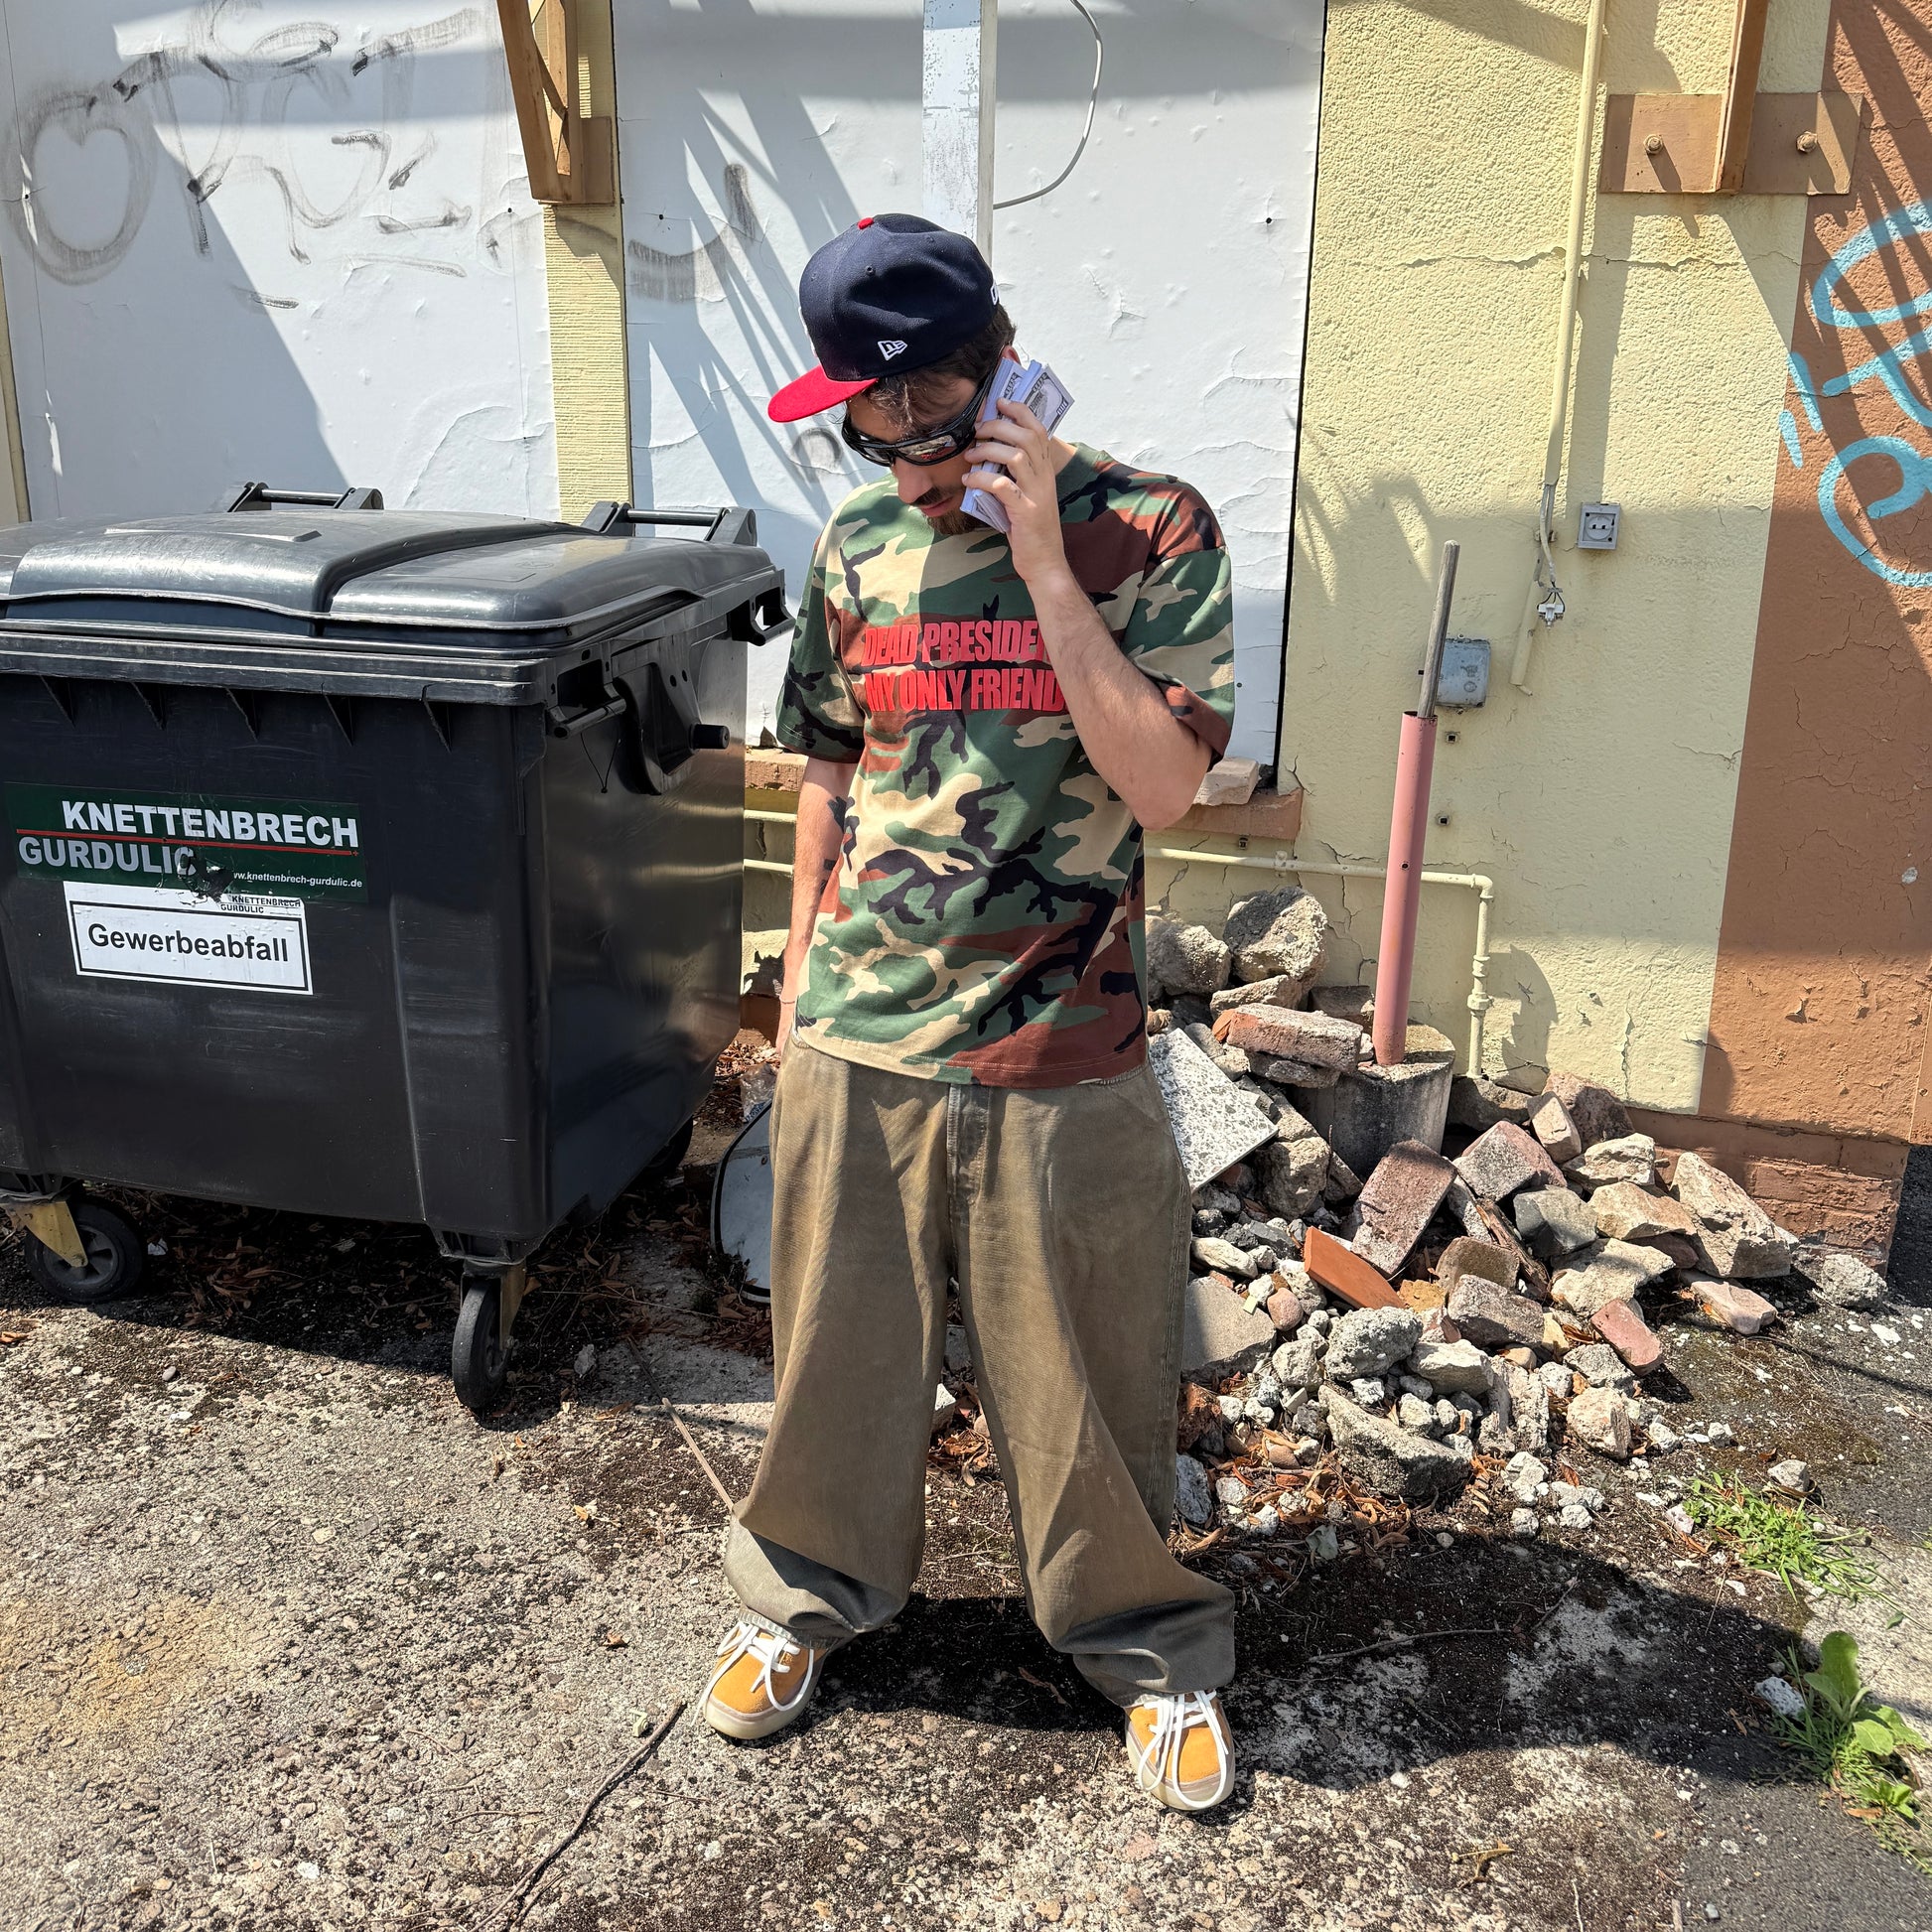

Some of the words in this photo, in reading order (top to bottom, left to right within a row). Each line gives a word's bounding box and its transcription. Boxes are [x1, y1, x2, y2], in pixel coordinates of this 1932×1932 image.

[861, 623, 918, 667] DEAD
[865, 672, 896, 712] MY
[899, 669, 966, 713] ONLY
[971, 668, 1068, 712] FRIEND
[62, 800, 359, 848] KNETTENBRECH
[18, 836, 197, 876] GURDULIC
[220, 903, 269, 913] GURDULIC
[231, 895, 301, 907] KNETTENBRECH
[87, 922, 289, 962] Gewerbeabfall
